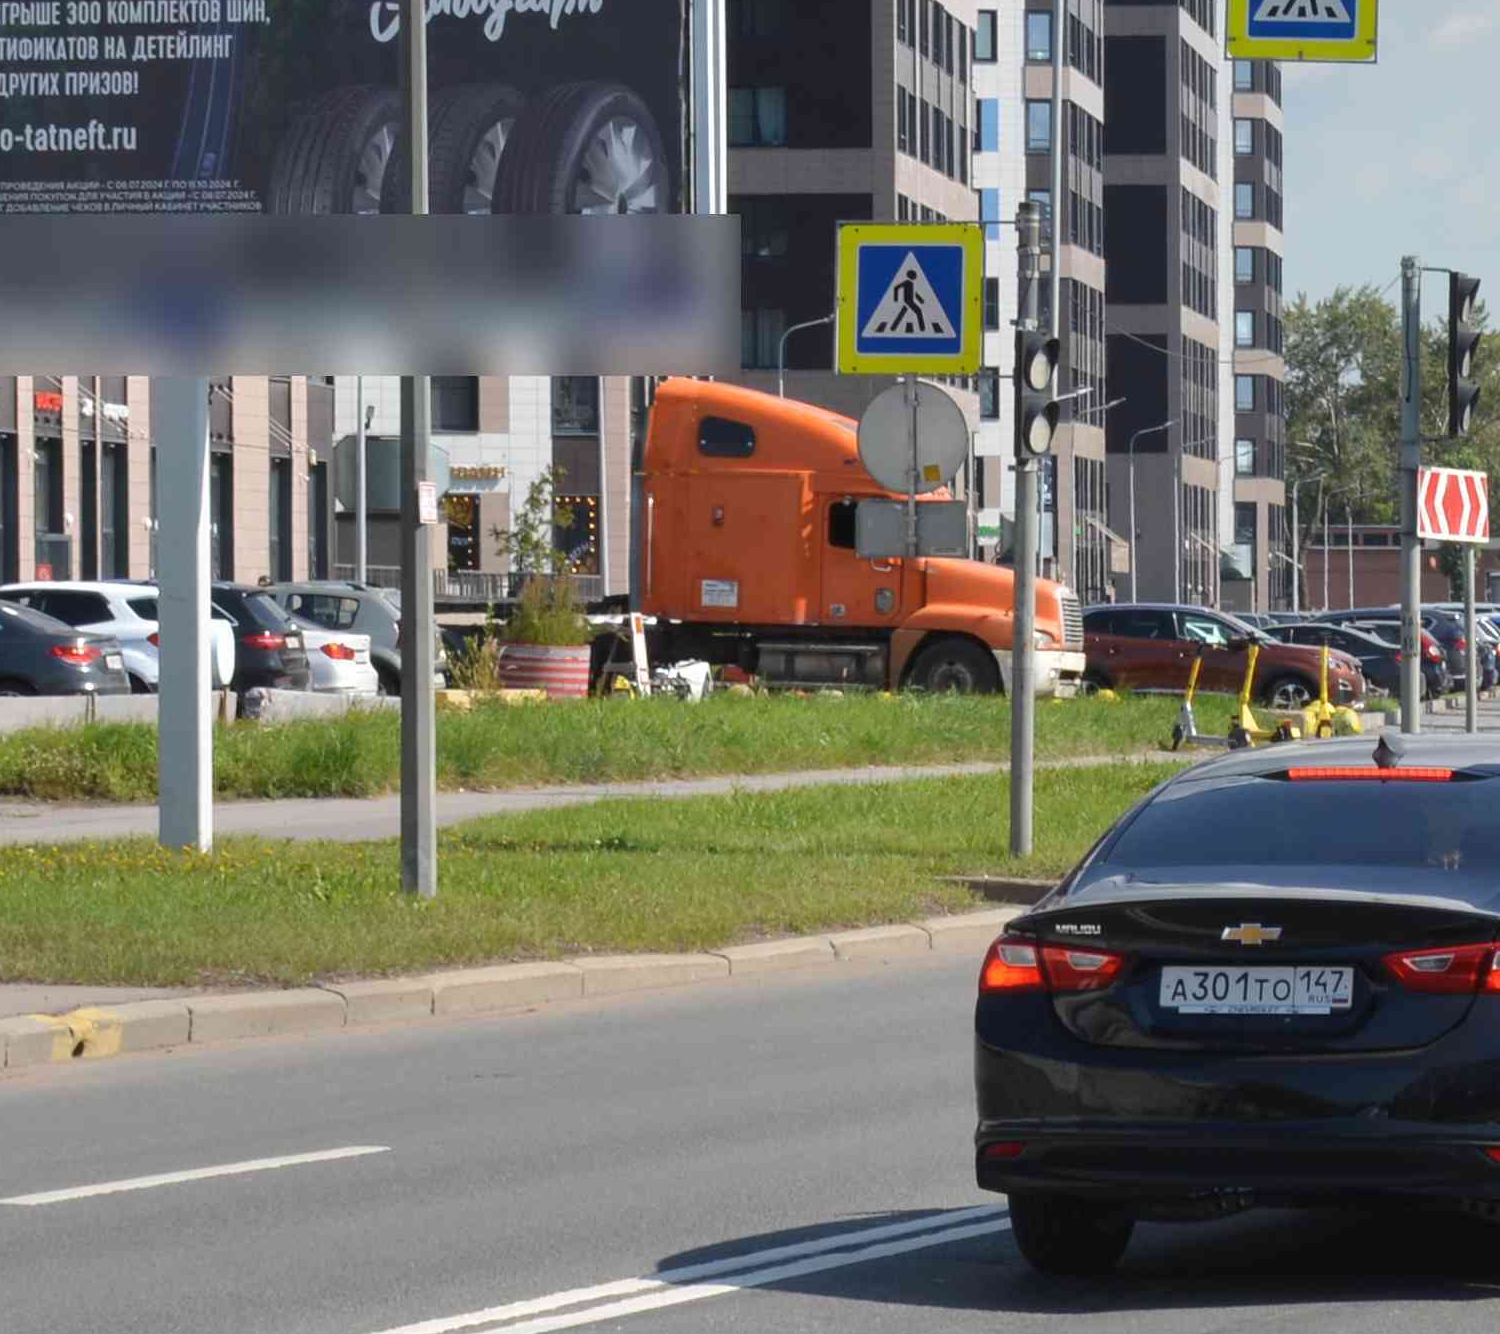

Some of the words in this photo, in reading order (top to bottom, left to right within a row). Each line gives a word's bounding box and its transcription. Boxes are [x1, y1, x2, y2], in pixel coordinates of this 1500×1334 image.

[67, 1, 100, 24] 300
[107, 0, 221, 24] КОМПЛЕКТОВ
[104, 35, 127, 59] НА
[131, 30, 233, 62] ДЕТЕЙЛИНГ
[65, 70, 140, 96] ПРИЗОВ!
[1055, 923, 1101, 935] MALIBU
[1308, 995, 1331, 1004] RUS
